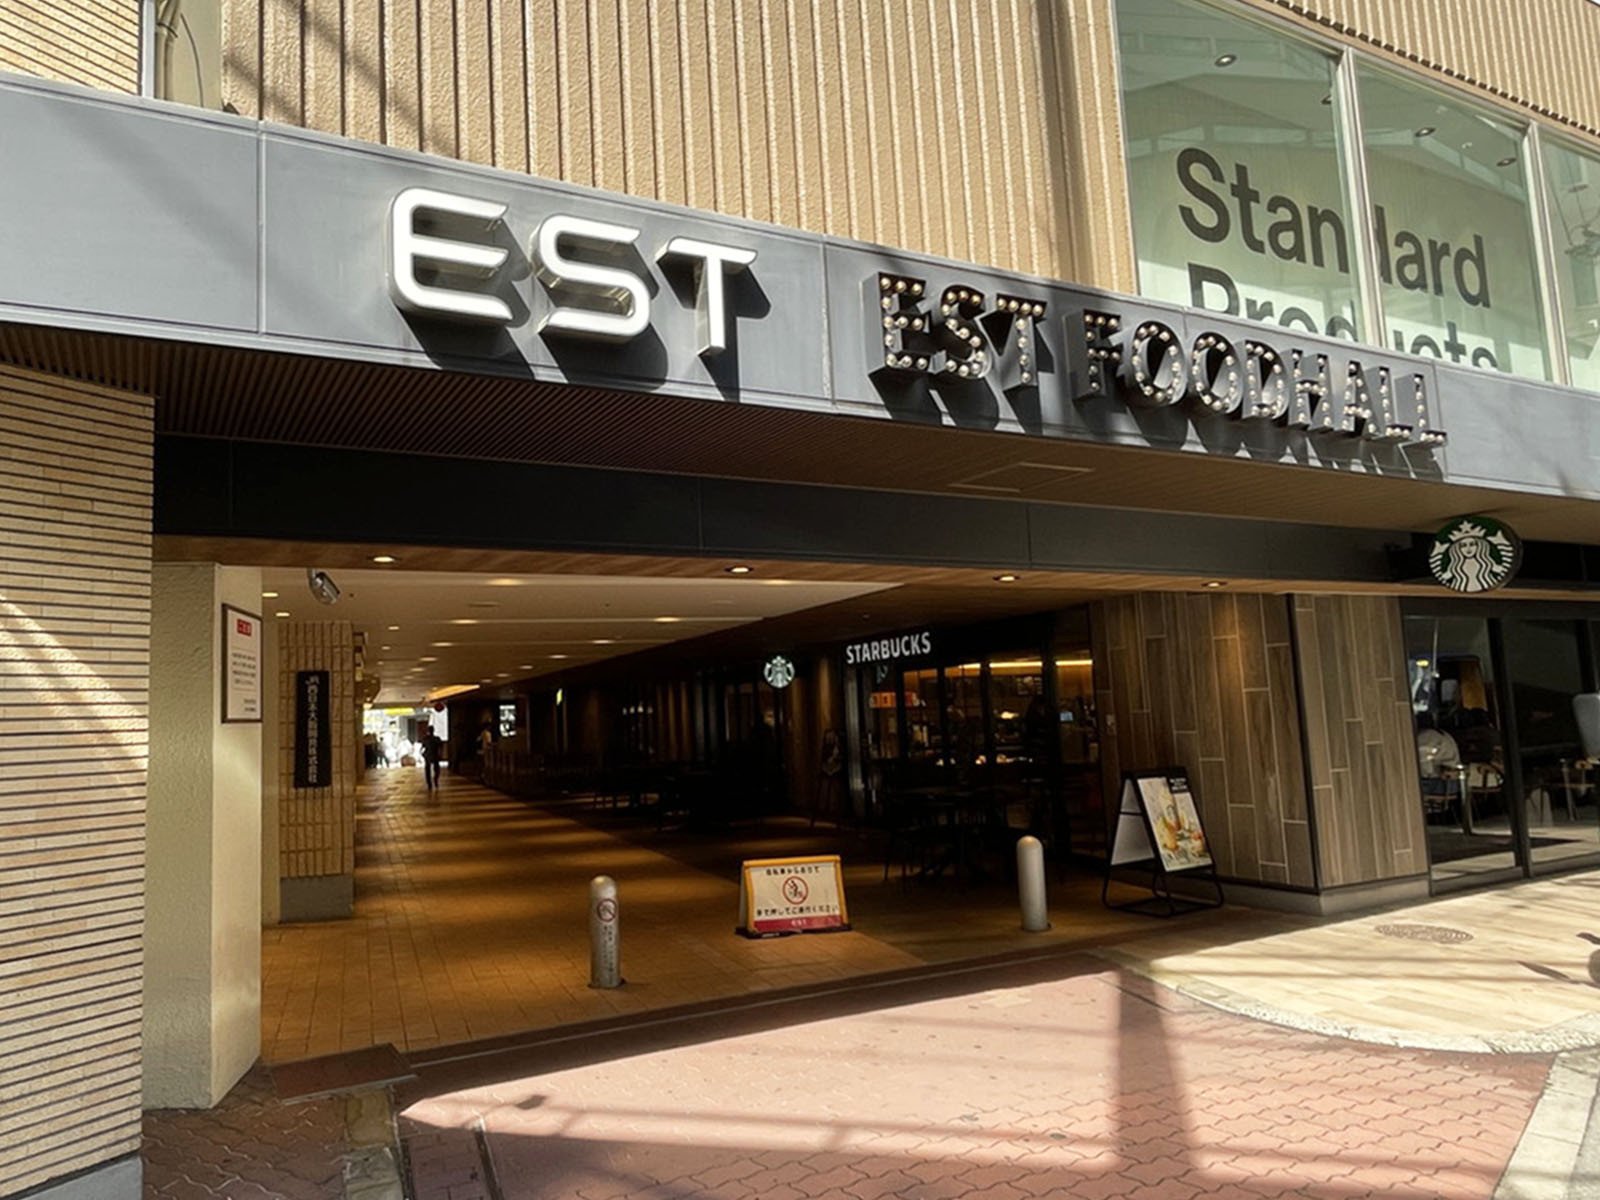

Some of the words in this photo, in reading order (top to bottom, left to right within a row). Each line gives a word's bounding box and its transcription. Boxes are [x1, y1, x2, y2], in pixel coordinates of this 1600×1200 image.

[391, 187, 758, 352] EST
[874, 271, 1048, 389] EST
[846, 632, 932, 665] STARBUCKS
